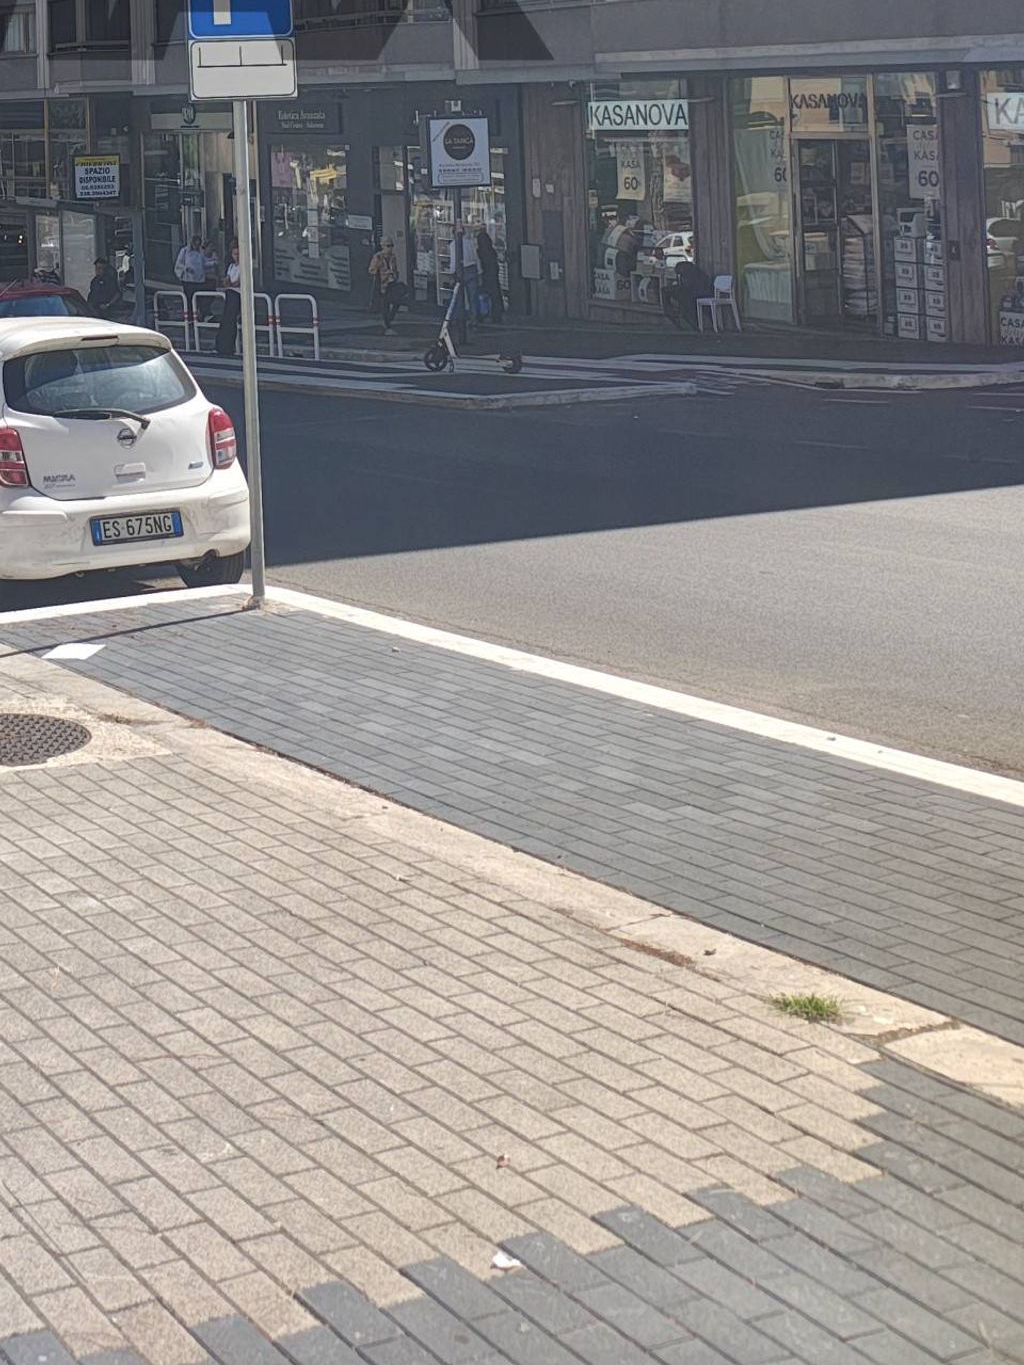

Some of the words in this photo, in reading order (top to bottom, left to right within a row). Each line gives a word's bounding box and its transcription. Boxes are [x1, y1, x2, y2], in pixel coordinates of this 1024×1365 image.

[589, 104, 688, 126] KASANOVA
[84, 167, 111, 175] SPAZIO
[79, 175, 116, 184] DISPONIBILE
[102, 520, 121, 539] ES
[126, 515, 173, 536] 675NG
